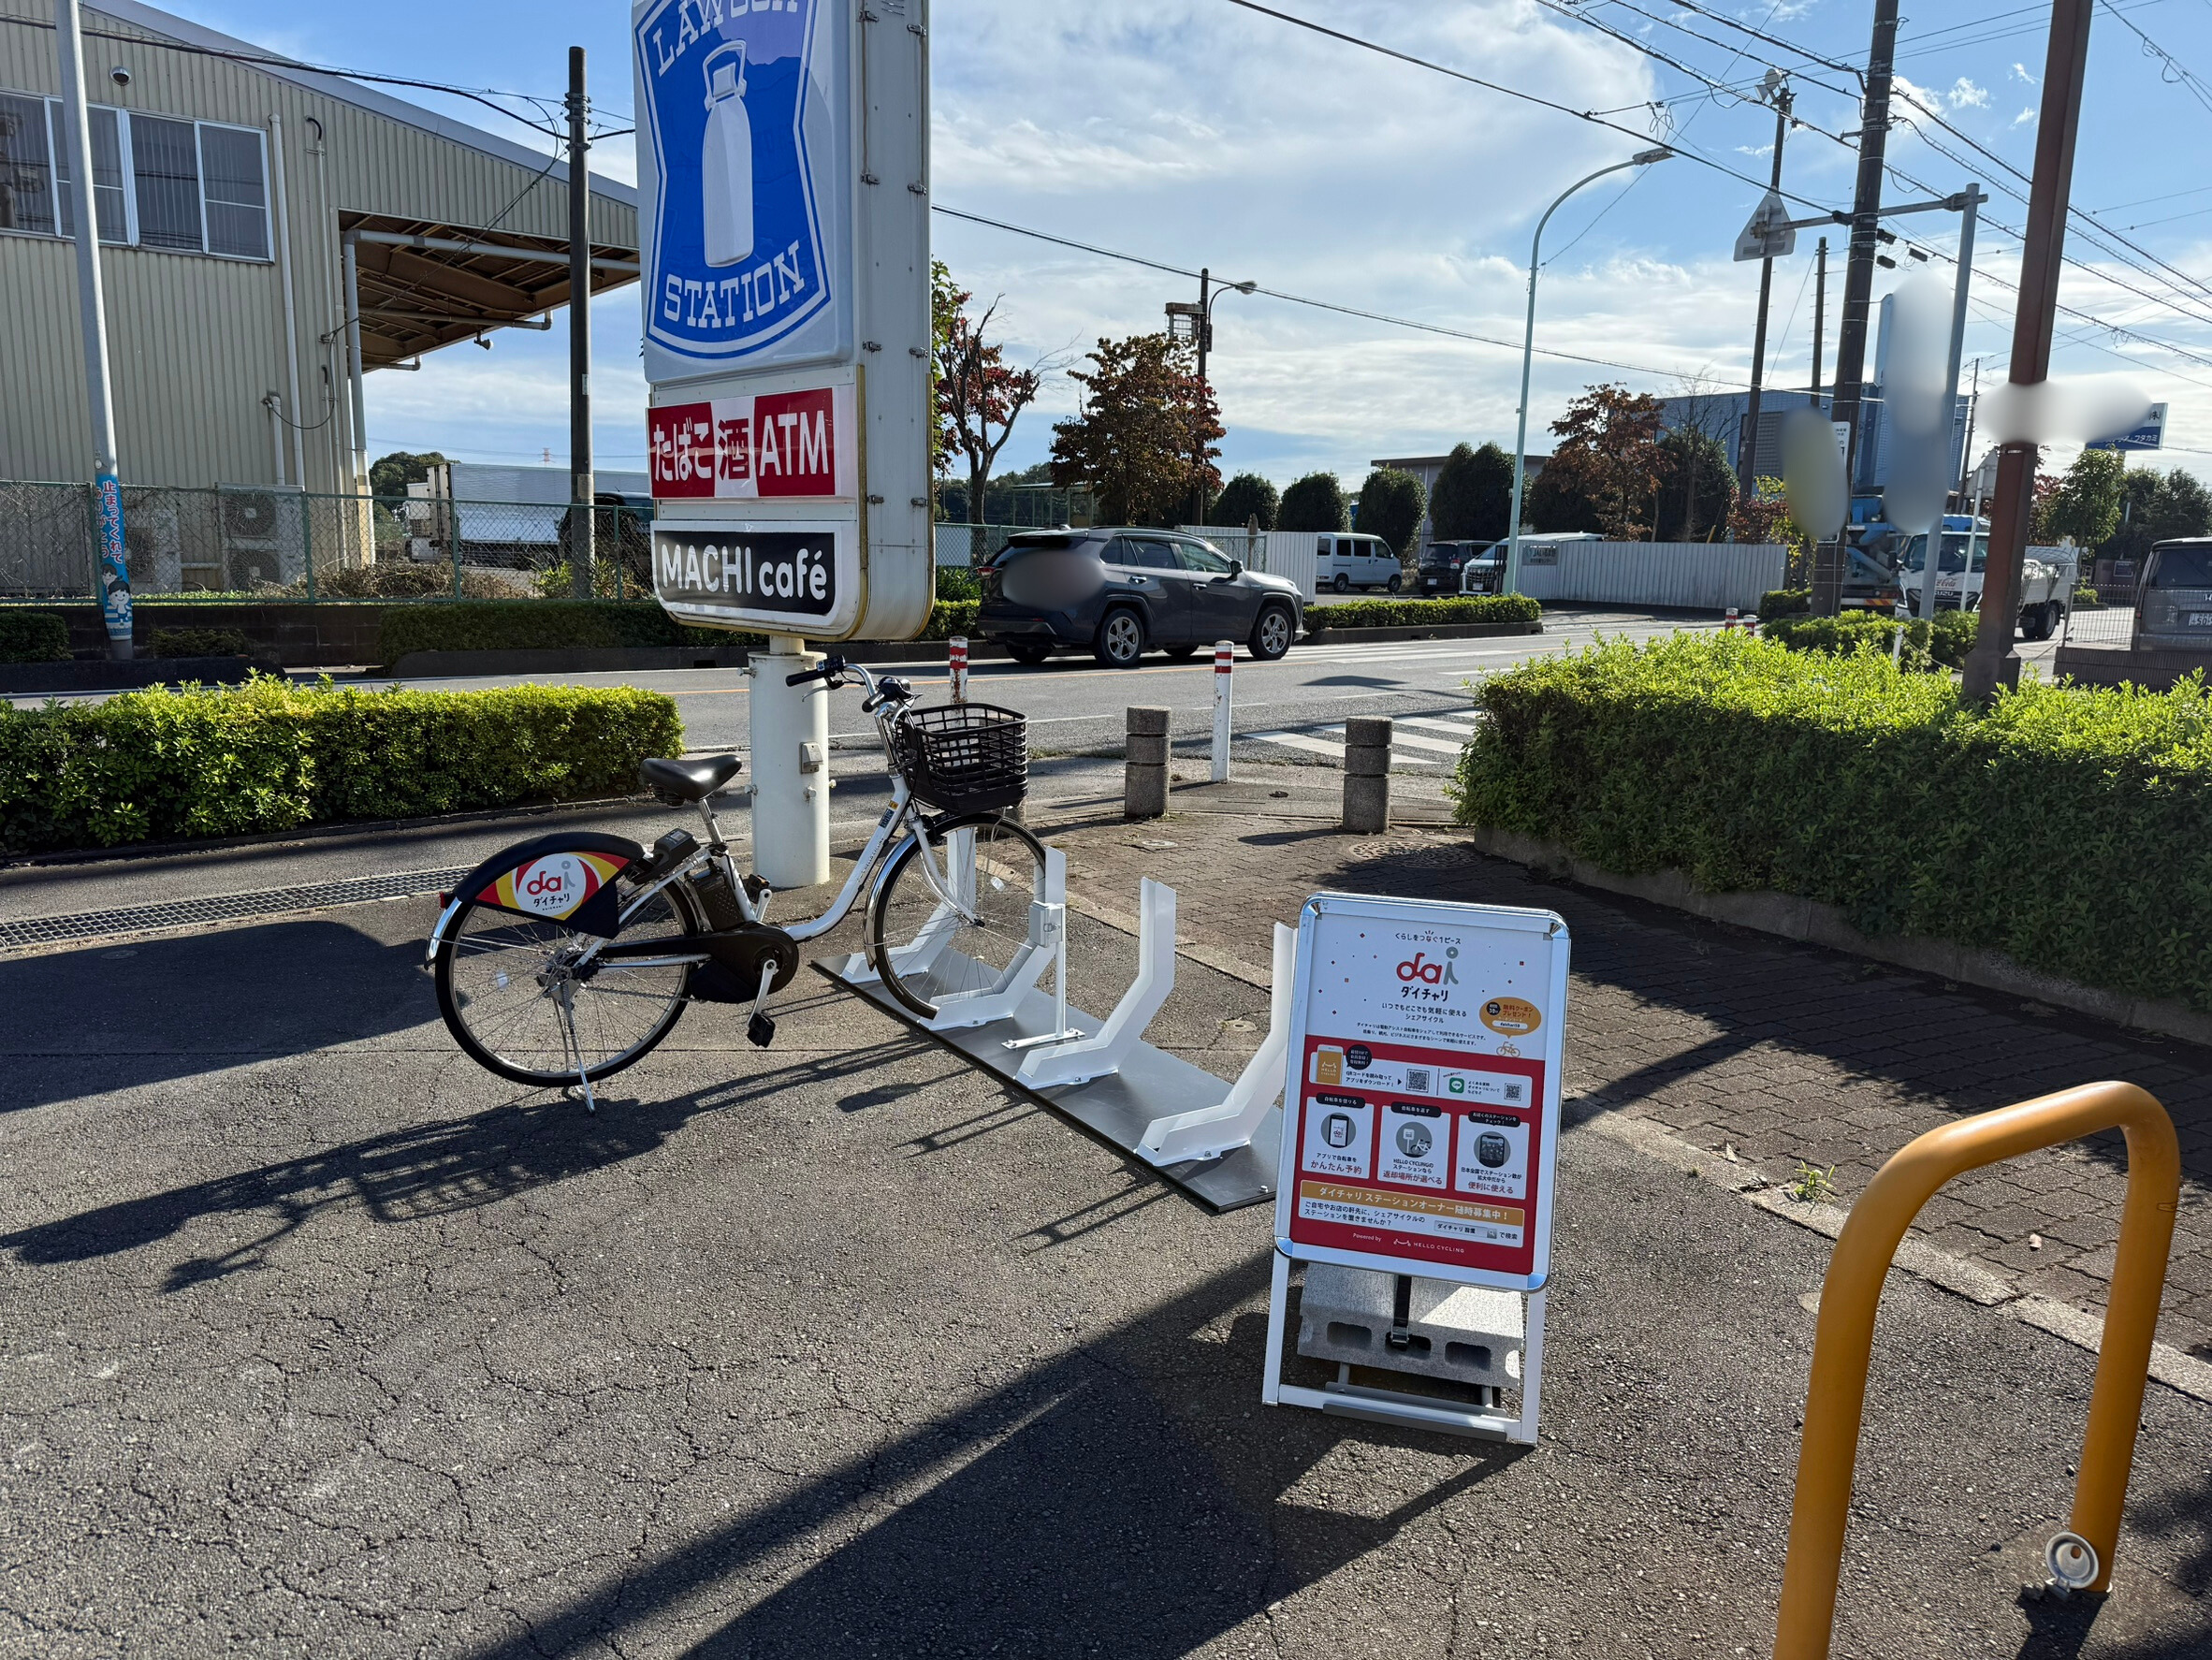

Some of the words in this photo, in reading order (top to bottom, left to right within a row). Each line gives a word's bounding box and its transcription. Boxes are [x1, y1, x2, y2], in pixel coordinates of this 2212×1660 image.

[653, 0, 797, 78] LAW
[663, 240, 805, 328] STATION
[654, 416, 712, 482] たばこ
[717, 417, 750, 481] 酒
[759, 410, 829, 476] ATM
[103, 480, 123, 564] 止まってくれて
[661, 544, 752, 594] MACHI
[759, 548, 827, 601] café
[527, 860, 575, 896] dai
[533, 893, 570, 908] ダイチャリ
[1396, 946, 1459, 985] dai
[1401, 985, 1448, 1002] ダイチャリ
[1381, 1003, 1467, 1017] いつでもどこでも気軽に使える
[1405, 1013, 1444, 1024] シェアサイクル
[1317, 1153, 1357, 1163] アプリで自転車を
[1310, 1160, 1362, 1175] かんたん予約
[1392, 1164, 1433, 1173] ステーションなら
[1461, 1167, 1522, 1180] 日本全国でステーション数が
[1383, 1170, 1443, 1185] 返却場所が選べる
[1477, 1174, 1506, 1184] 拡大中だから
[1319, 1187, 1362, 1200] ダイチャリ
[1468, 1181, 1514, 1194] 便利に使える
[1304, 1208, 1392, 1226] ステーションを置きませんか？
[1305, 1201, 1425, 1223] ご自宅やお店の軒先に、シェアサイクルの
[1353, 1232, 1375, 1241] Powered
[1436, 1245, 1464, 1254] CYCLING
